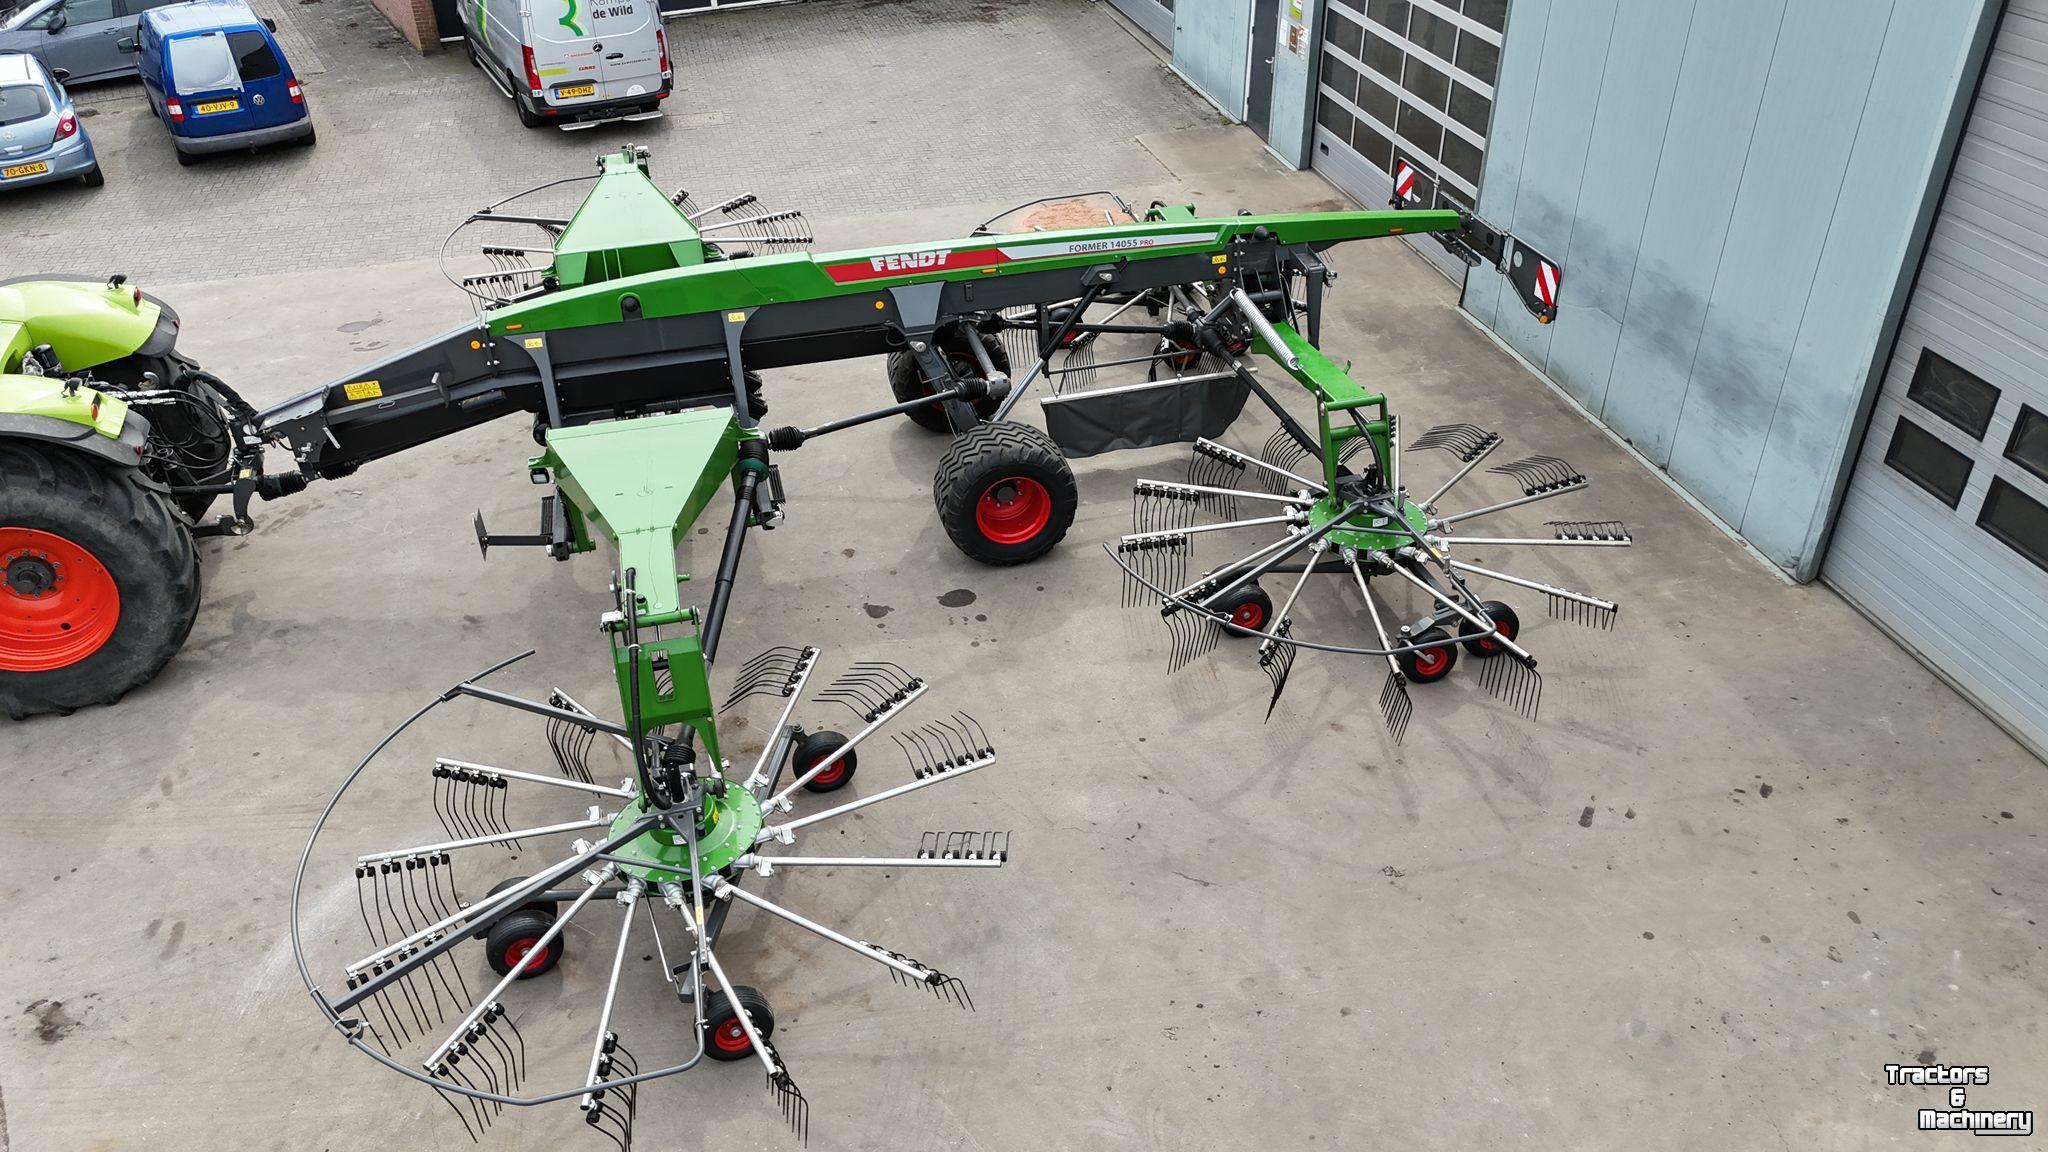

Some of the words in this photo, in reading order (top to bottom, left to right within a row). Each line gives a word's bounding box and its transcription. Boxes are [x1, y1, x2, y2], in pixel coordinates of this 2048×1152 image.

[593, 9, 606, 19] de
[608, 5, 633, 17] Wild
[4, 163, 44, 176] 70-GKN-8
[1069, 241, 1108, 252] FORMER
[1110, 239, 1138, 249] 14055
[870, 249, 952, 272] FENDT
